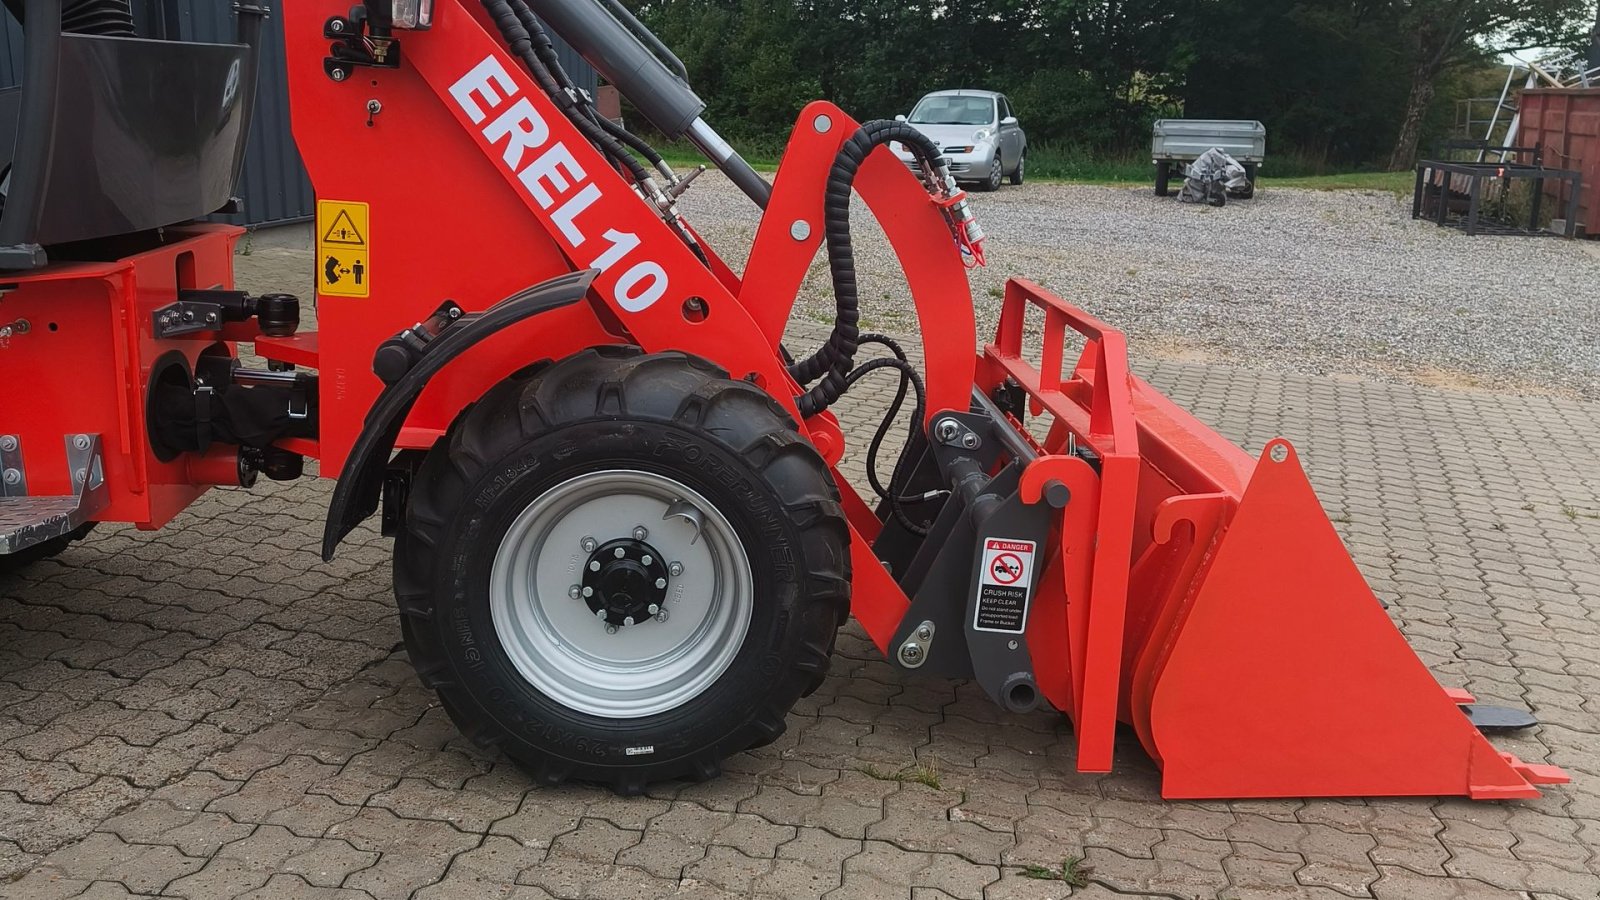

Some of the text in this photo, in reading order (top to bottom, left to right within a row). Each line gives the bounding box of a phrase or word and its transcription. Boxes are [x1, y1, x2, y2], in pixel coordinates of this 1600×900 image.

[448, 54, 669, 312] EREL 10
[1002, 542, 1029, 551] DANGER
[983, 588, 1024, 598] CRUSH RISK
